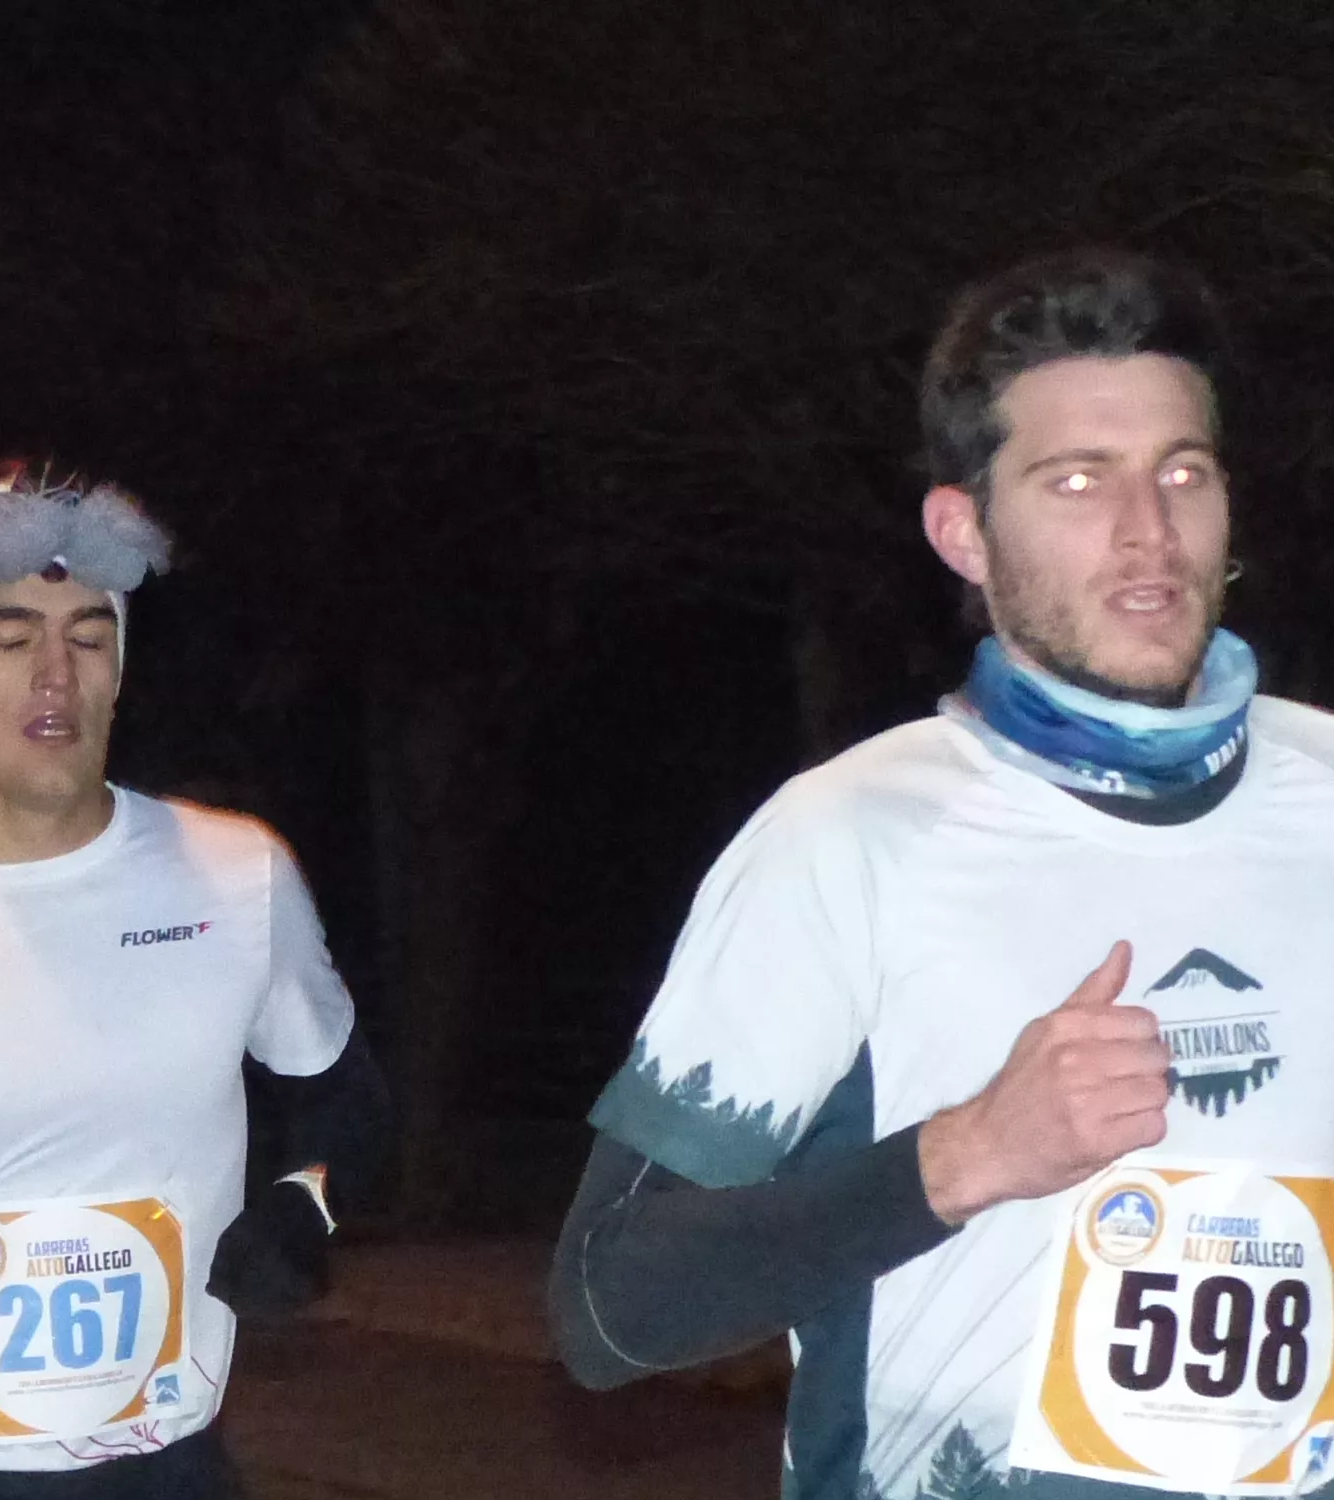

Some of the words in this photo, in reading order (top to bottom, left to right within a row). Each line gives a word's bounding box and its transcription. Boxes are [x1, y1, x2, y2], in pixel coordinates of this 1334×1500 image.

[121, 926, 193, 947] FLOWER
[1187, 1213, 1261, 1237] CARRERAS
[26, 1237, 90, 1257] CARRERAS
[1181, 1237, 1305, 1268] ALTOGALLEGO
[26, 1249, 132, 1278] ALTOGALLEGO
[1108, 1270, 1312, 1402] 598
